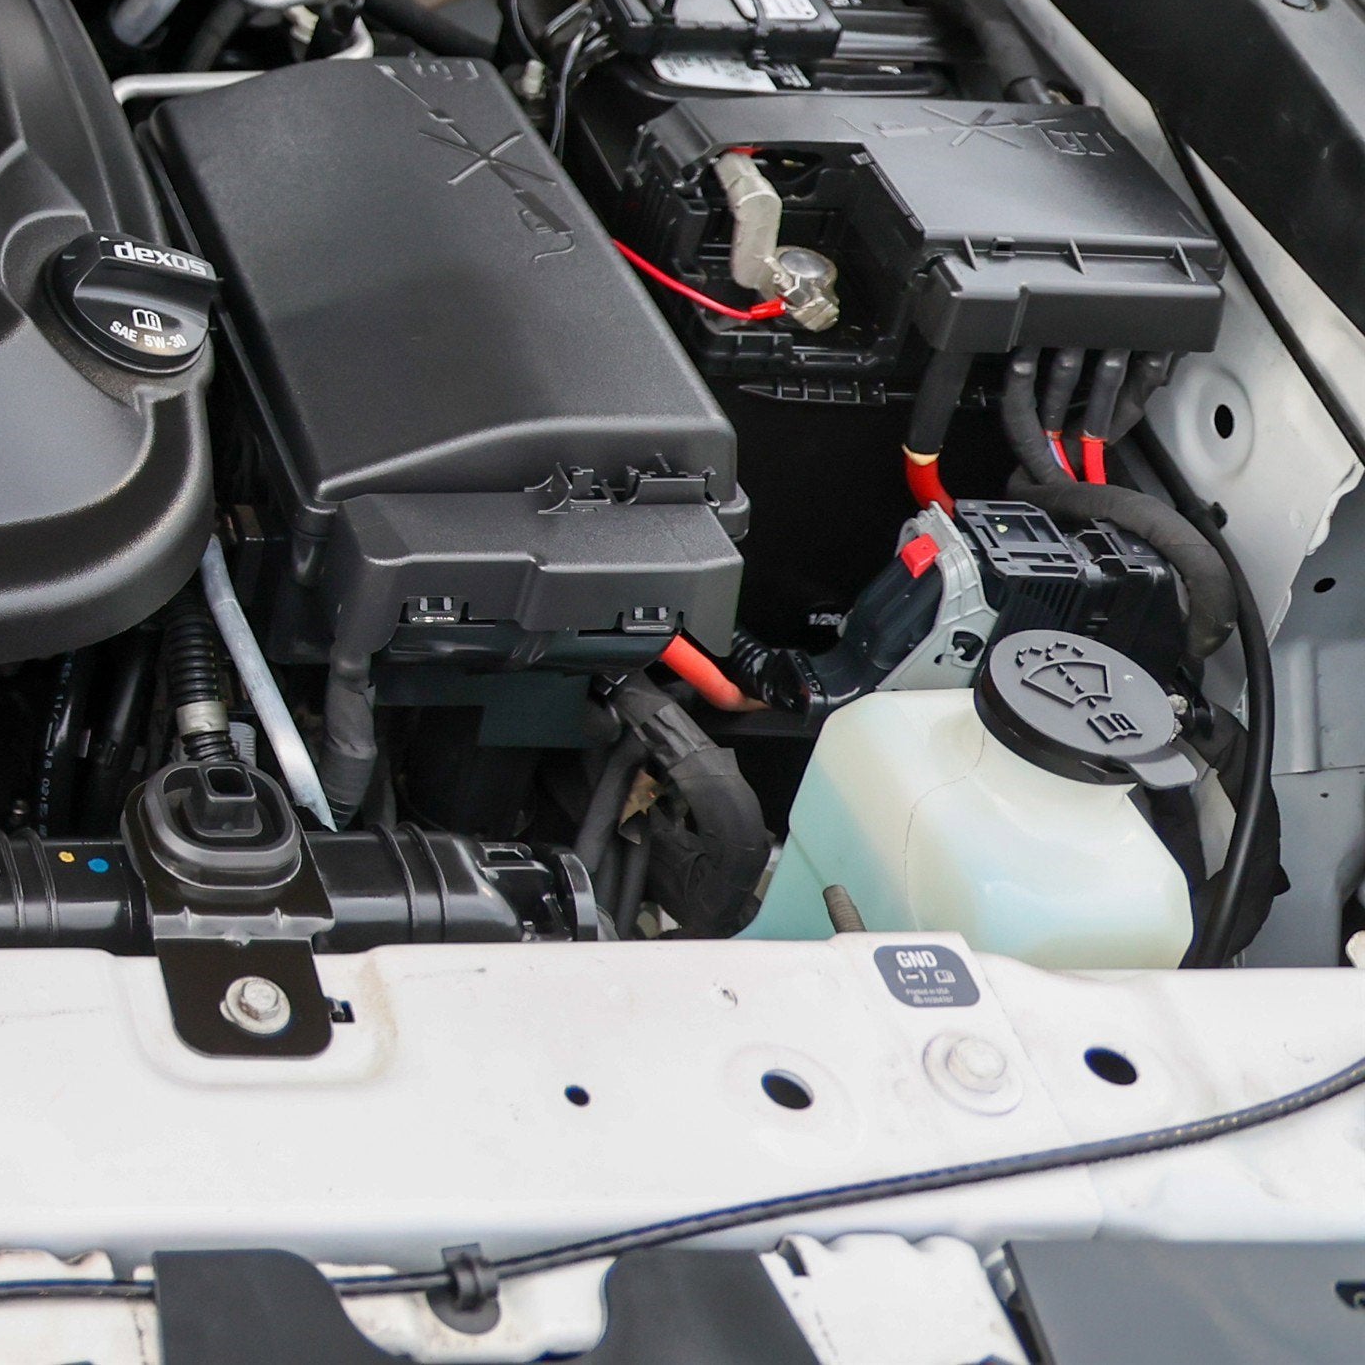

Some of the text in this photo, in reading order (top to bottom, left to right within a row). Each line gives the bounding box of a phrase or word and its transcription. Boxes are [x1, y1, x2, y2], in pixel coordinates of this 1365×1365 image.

[113, 241, 207, 276] dexos
[110, 320, 187, 349] SAE 5W-30
[895, 950, 938, 968] GND
